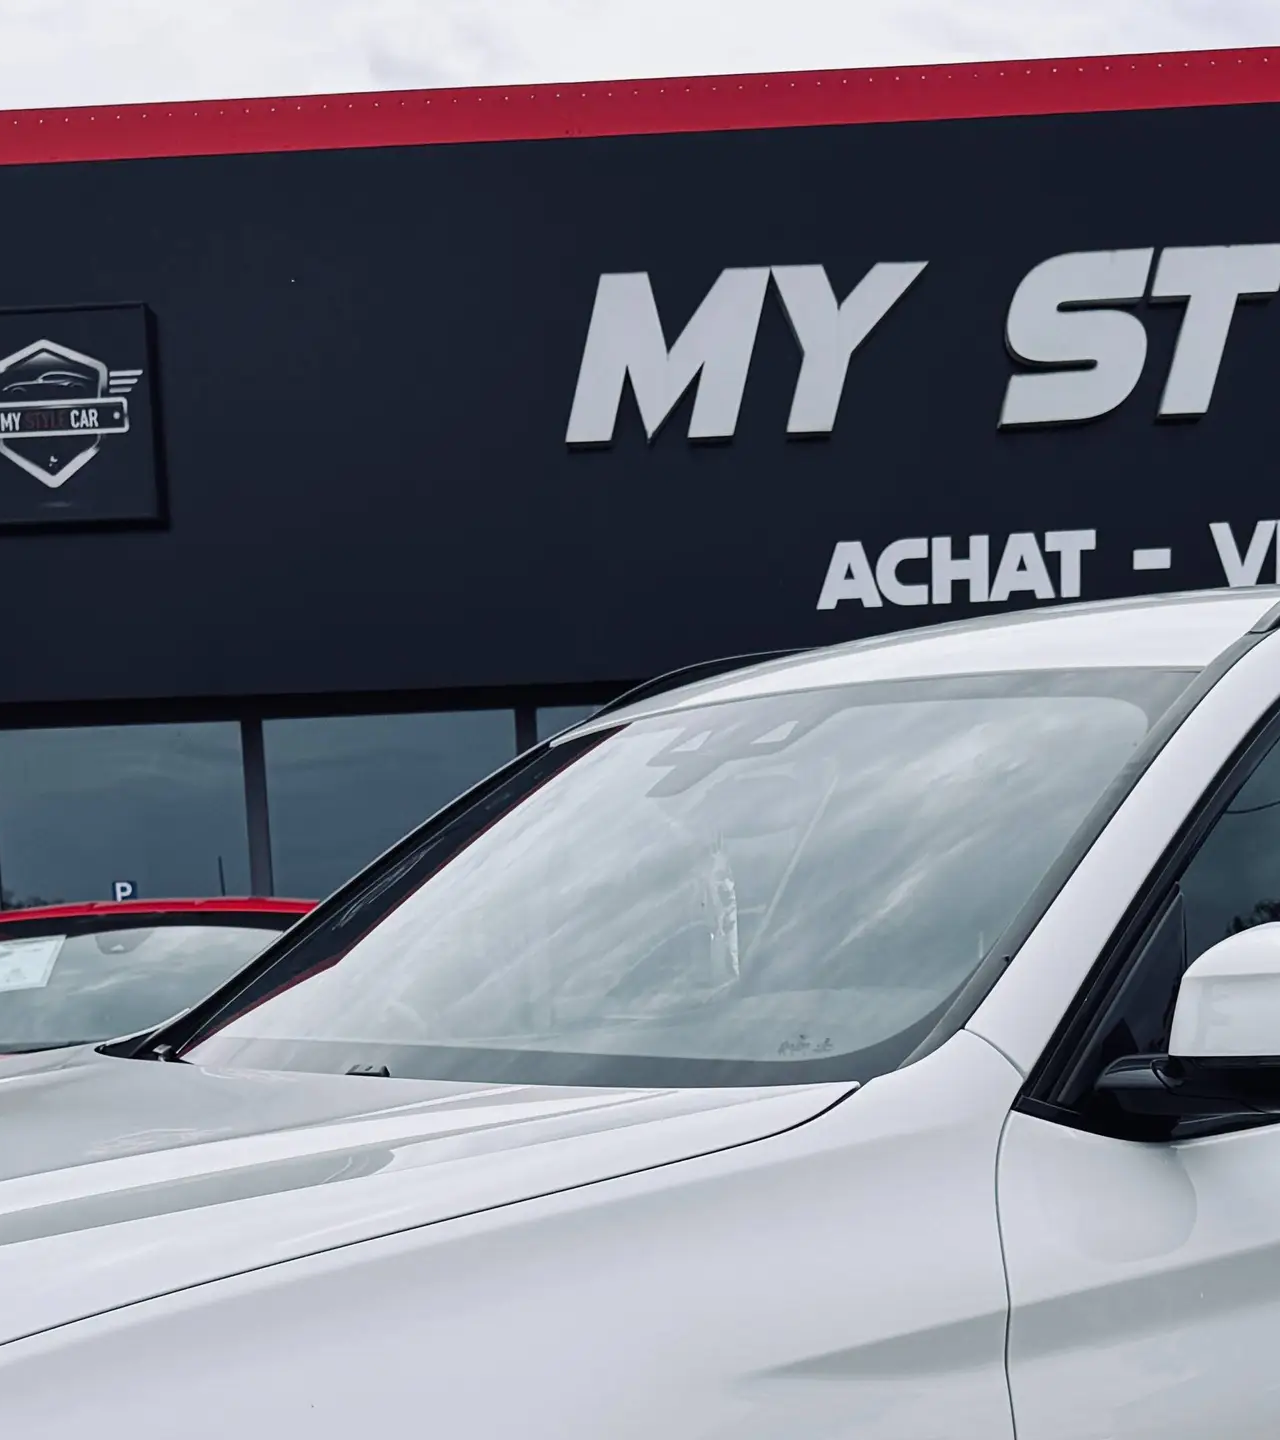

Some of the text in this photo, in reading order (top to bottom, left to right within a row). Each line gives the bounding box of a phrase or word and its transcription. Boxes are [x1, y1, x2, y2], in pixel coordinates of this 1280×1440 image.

[565, 261, 929, 446] MY
[0, 412, 21, 432] MY
[70, 408, 99, 429] CAR
[816, 528, 1097, 611] ACHAT
[115, 882, 133, 902] P
